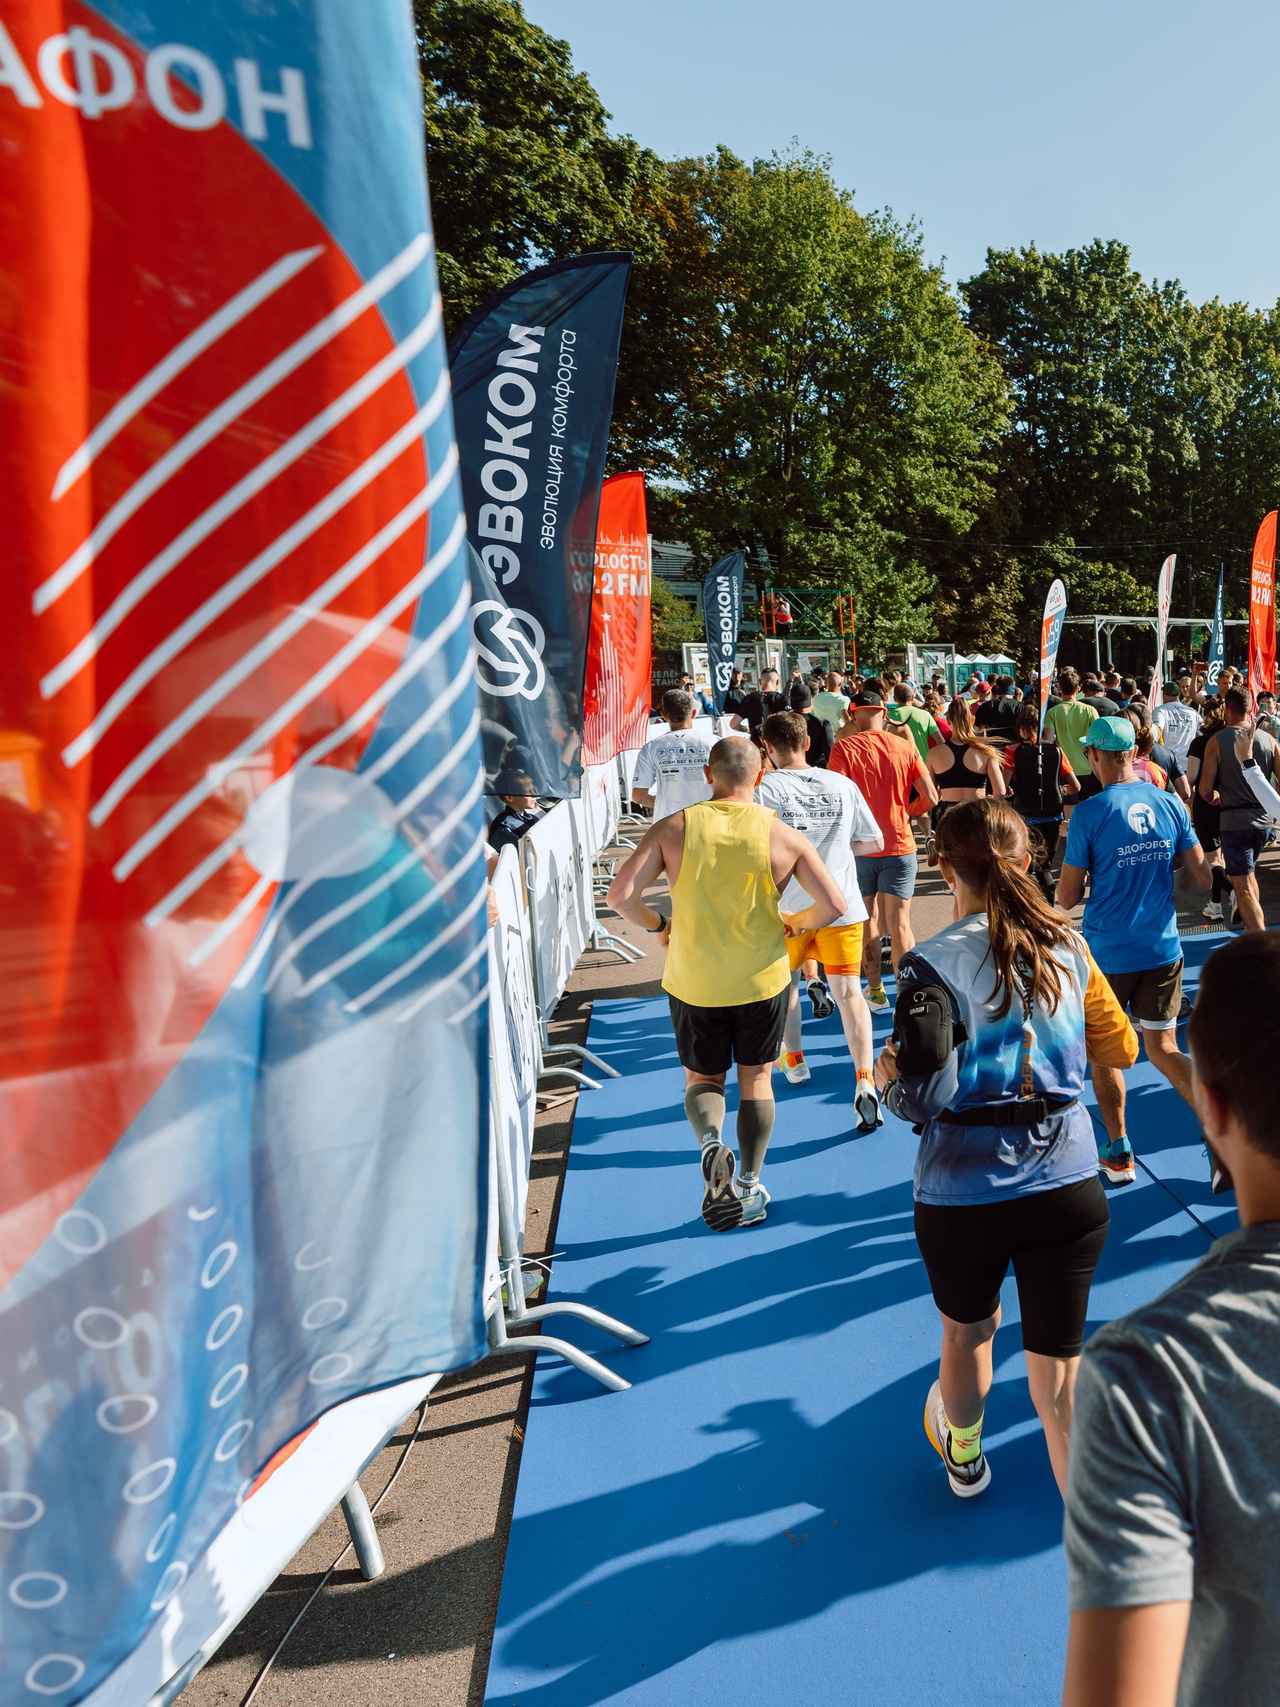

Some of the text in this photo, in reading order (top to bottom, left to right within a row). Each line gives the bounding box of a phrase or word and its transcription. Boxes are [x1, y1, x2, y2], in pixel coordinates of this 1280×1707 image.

[540, 328, 578, 550] эволюция комфорта
[477, 322, 547, 586] ЭВОКОМ
[617, 573, 648, 596] FM
[716, 575, 733, 657] ЭВОКОМ
[781, 811, 804, 819] ЛЮБИ
[1117, 839, 1172, 857] ЗДОРОВОЕ
[1117, 851, 1172, 869] ОТЕЧЕСТВО
[1022, 1027, 1034, 1050] ON
